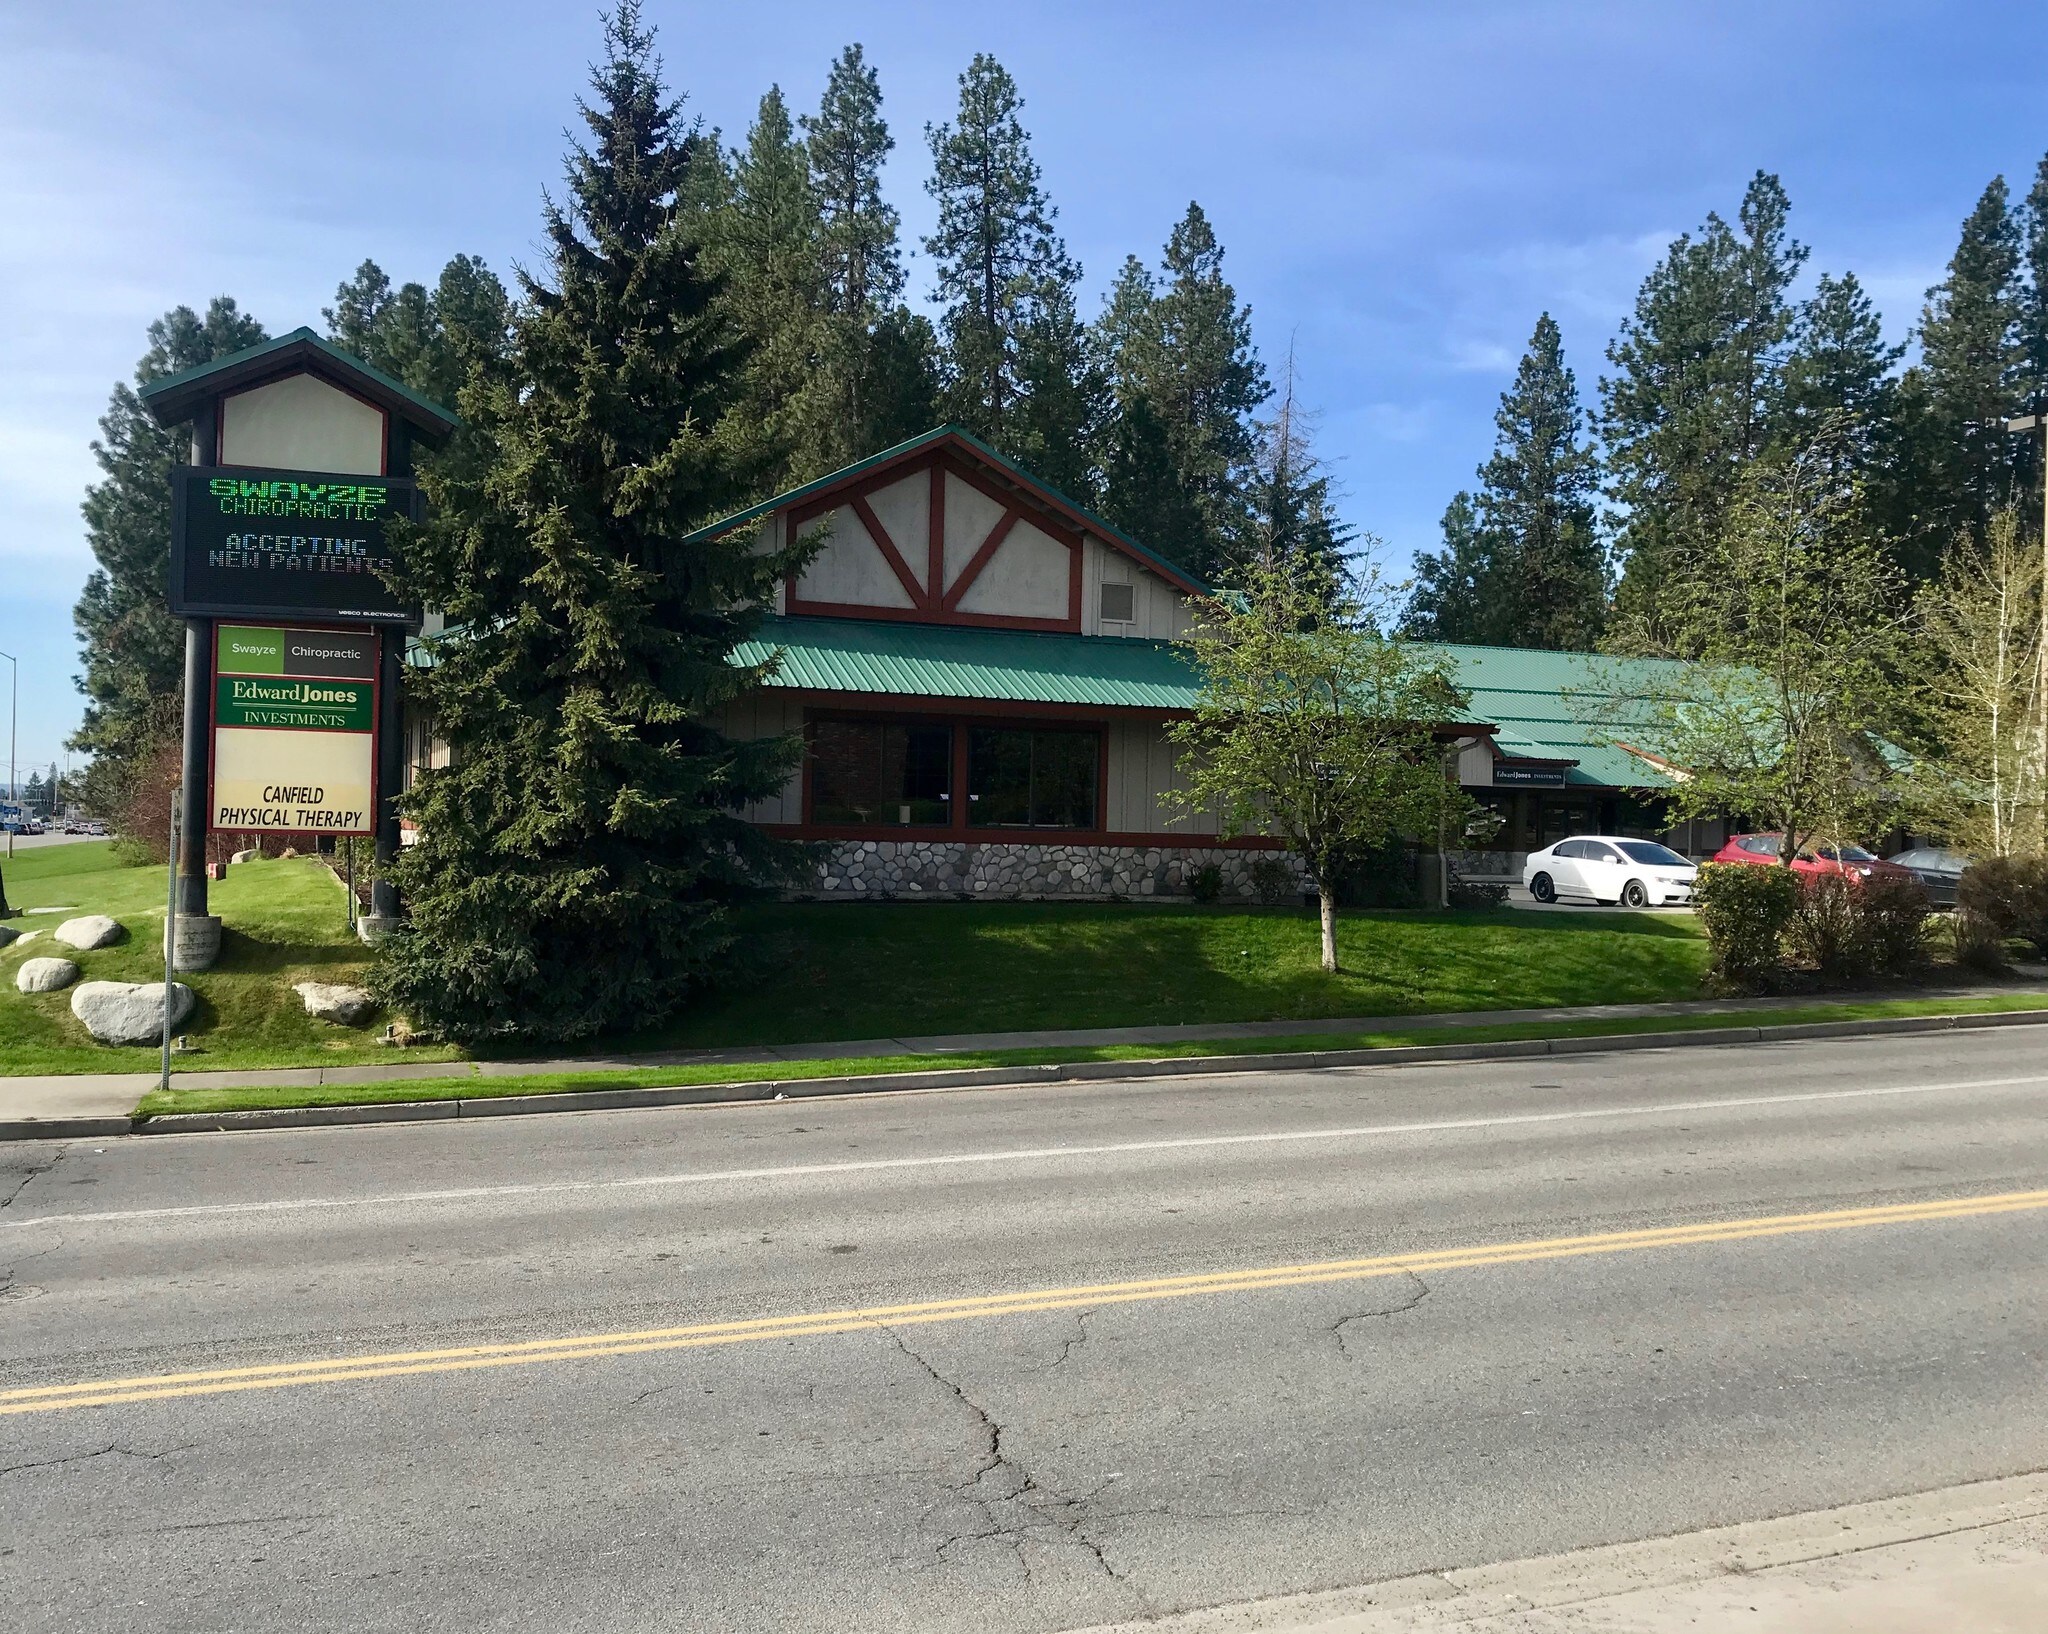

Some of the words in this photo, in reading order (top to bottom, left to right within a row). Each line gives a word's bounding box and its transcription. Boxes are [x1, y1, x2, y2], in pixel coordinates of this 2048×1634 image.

[208, 478, 387, 504] SWAYZE
[220, 497, 378, 521] CHIROPRACTIC
[226, 533, 367, 556] ACCEPTING
[209, 550, 260, 568] NEW
[269, 554, 394, 574] PATIENTS
[231, 643, 277, 656] Swayze
[291, 646, 361, 659] Chiropractic
[244, 711, 346, 727] INVESTMENTS
[263, 786, 324, 804] CANFIELD
[219, 808, 290, 826] PHYSICAL
[296, 810, 363, 828] THERAPY
